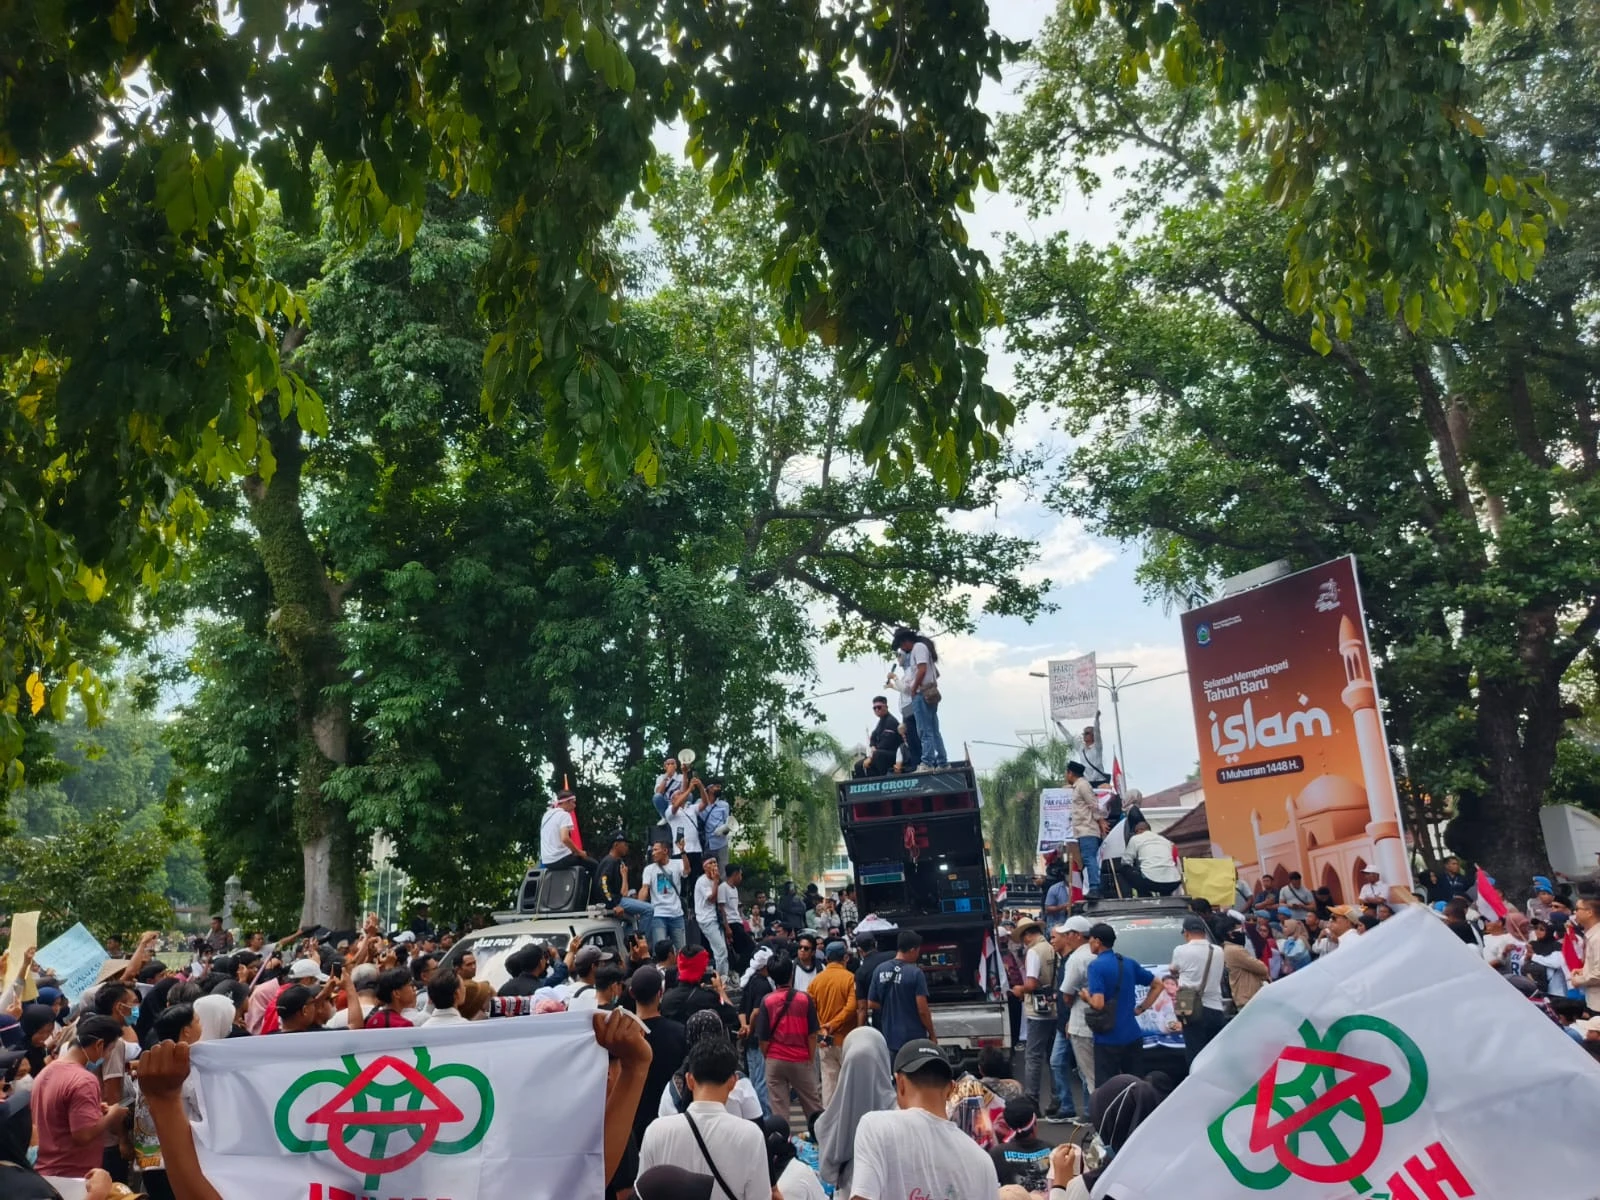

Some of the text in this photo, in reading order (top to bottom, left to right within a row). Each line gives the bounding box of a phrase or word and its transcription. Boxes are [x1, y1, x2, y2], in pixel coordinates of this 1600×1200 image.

[1203, 659, 1288, 689] Selamat Memperingati
[1204, 678, 1269, 702] Tahun Baru
[1220, 760, 1299, 780] 1 Muharram 1448 H.
[849, 783, 881, 794] RIZKI
[881, 779, 919, 790] GROUP
